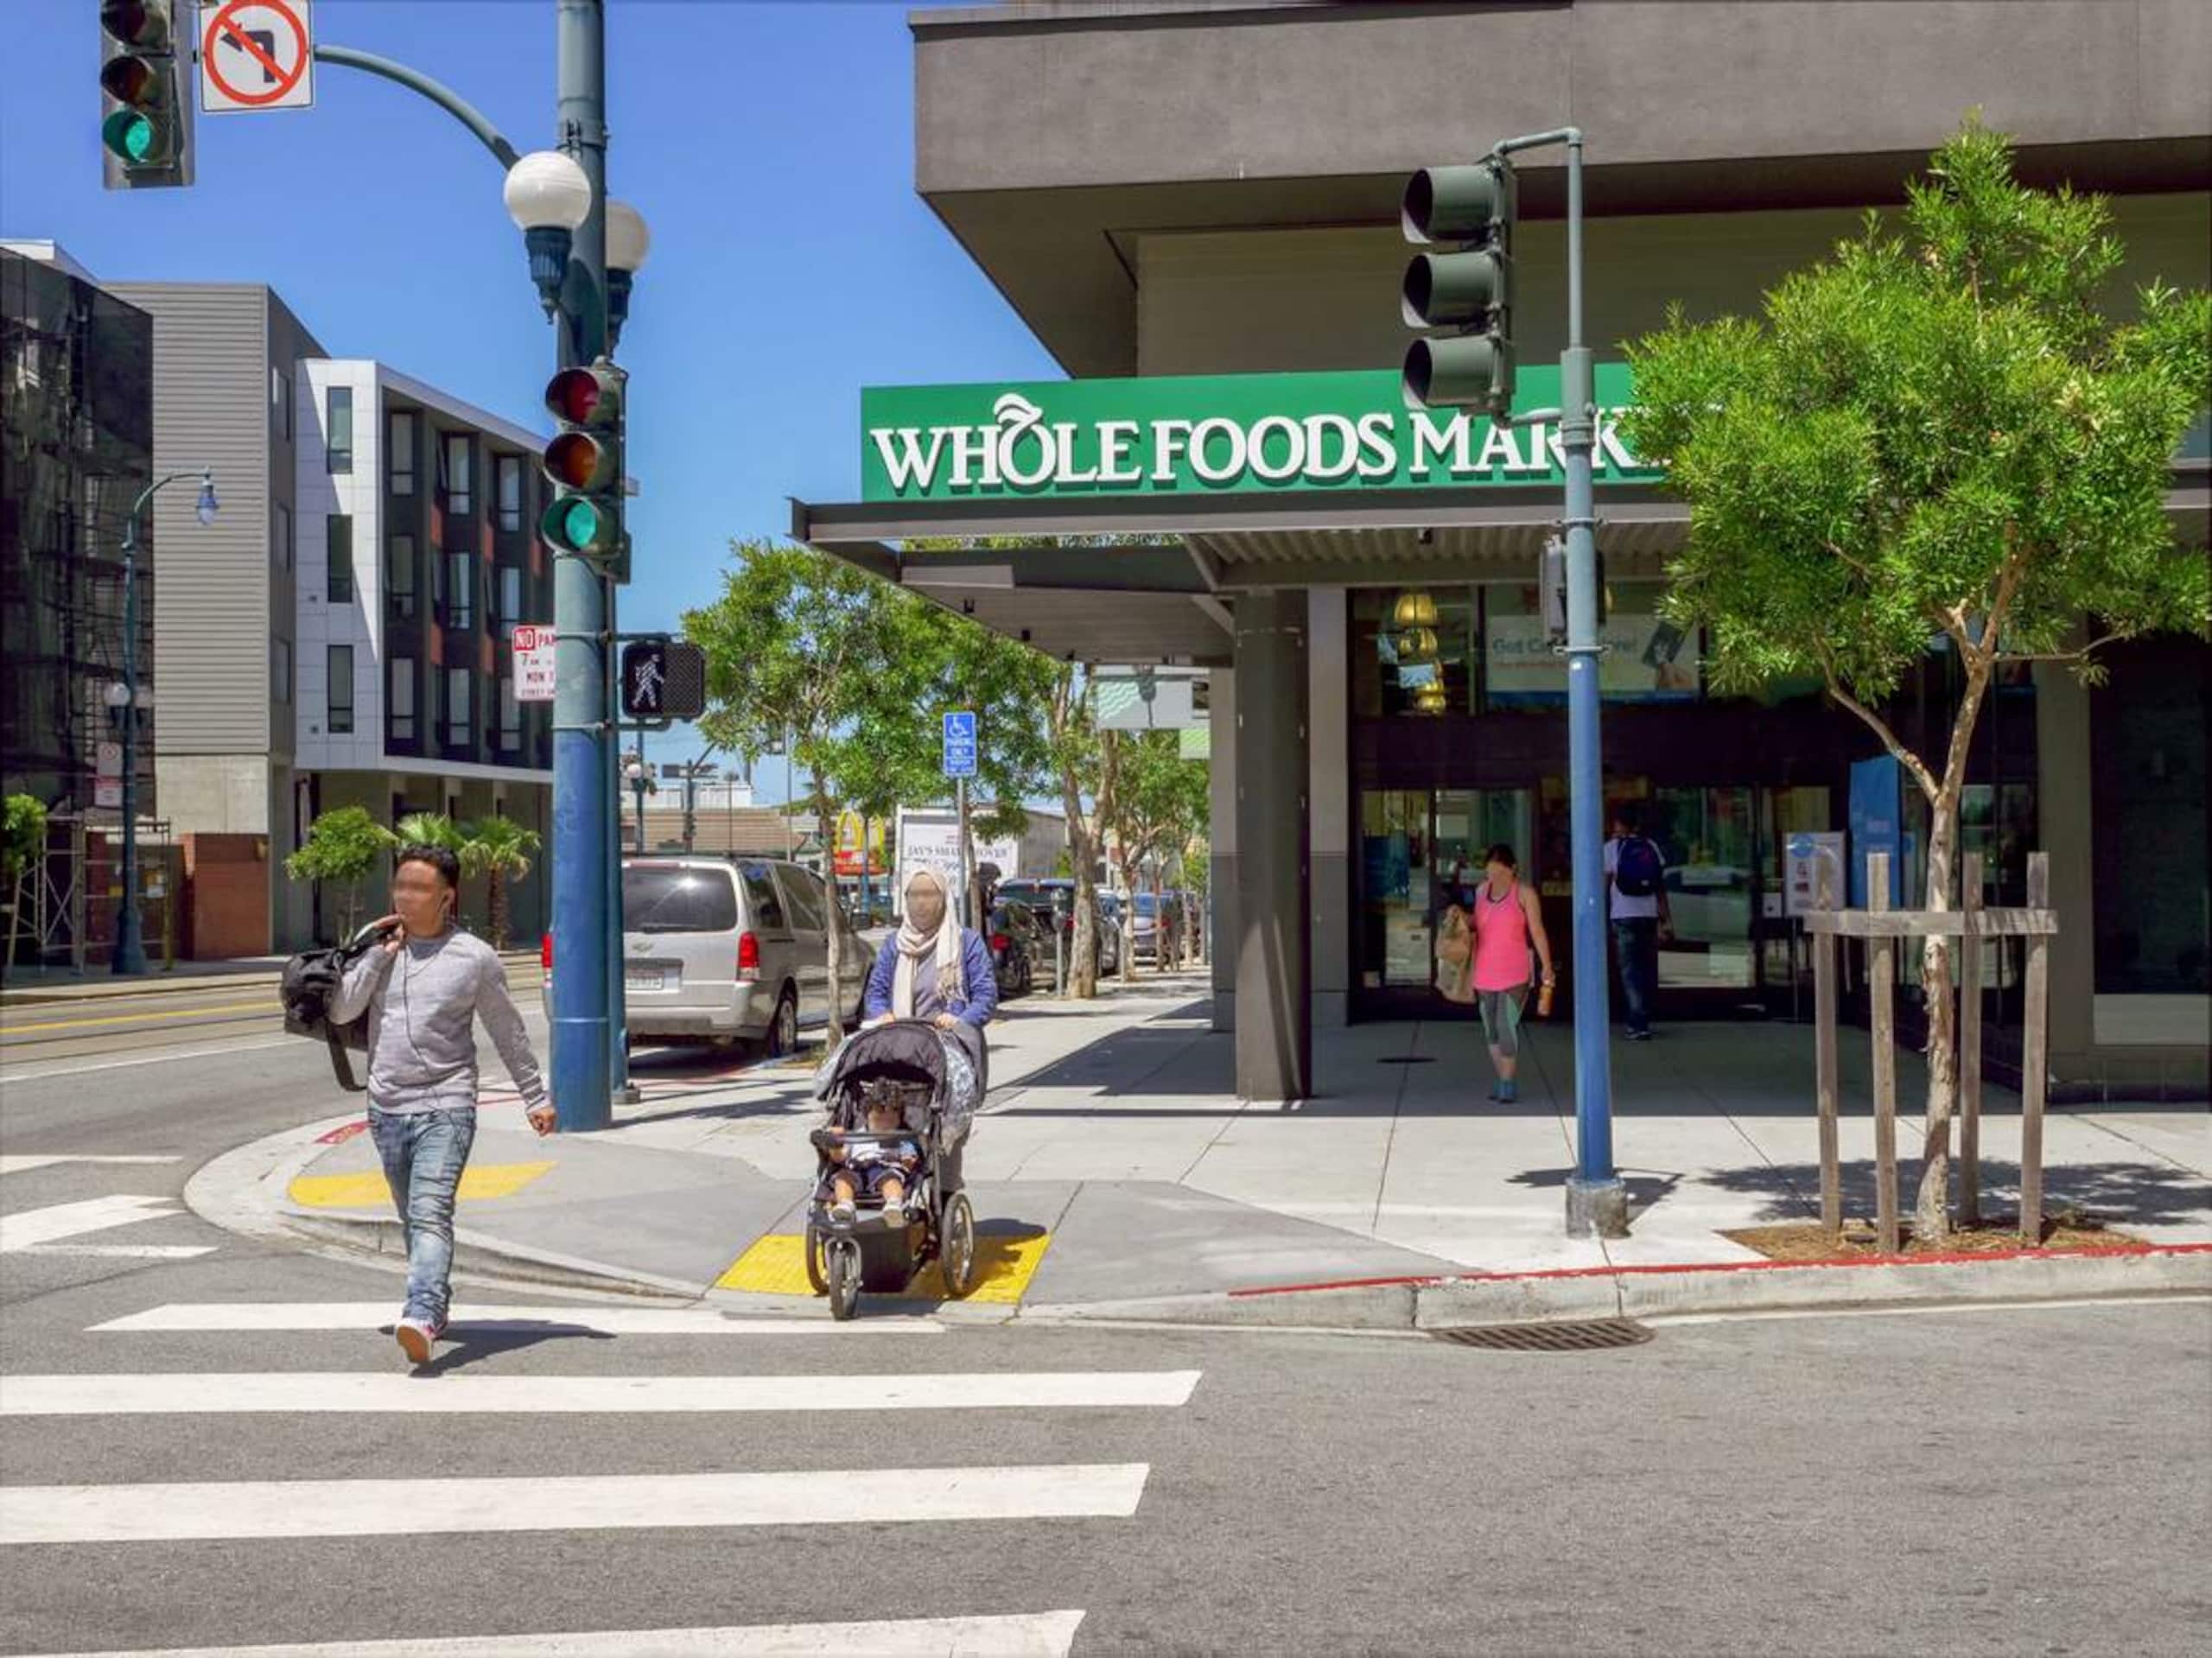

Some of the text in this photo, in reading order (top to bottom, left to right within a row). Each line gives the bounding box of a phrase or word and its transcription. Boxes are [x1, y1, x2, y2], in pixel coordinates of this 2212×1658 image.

[870, 394, 1671, 489] WHOLE FOODS MARK
[516, 631, 534, 648] NO
